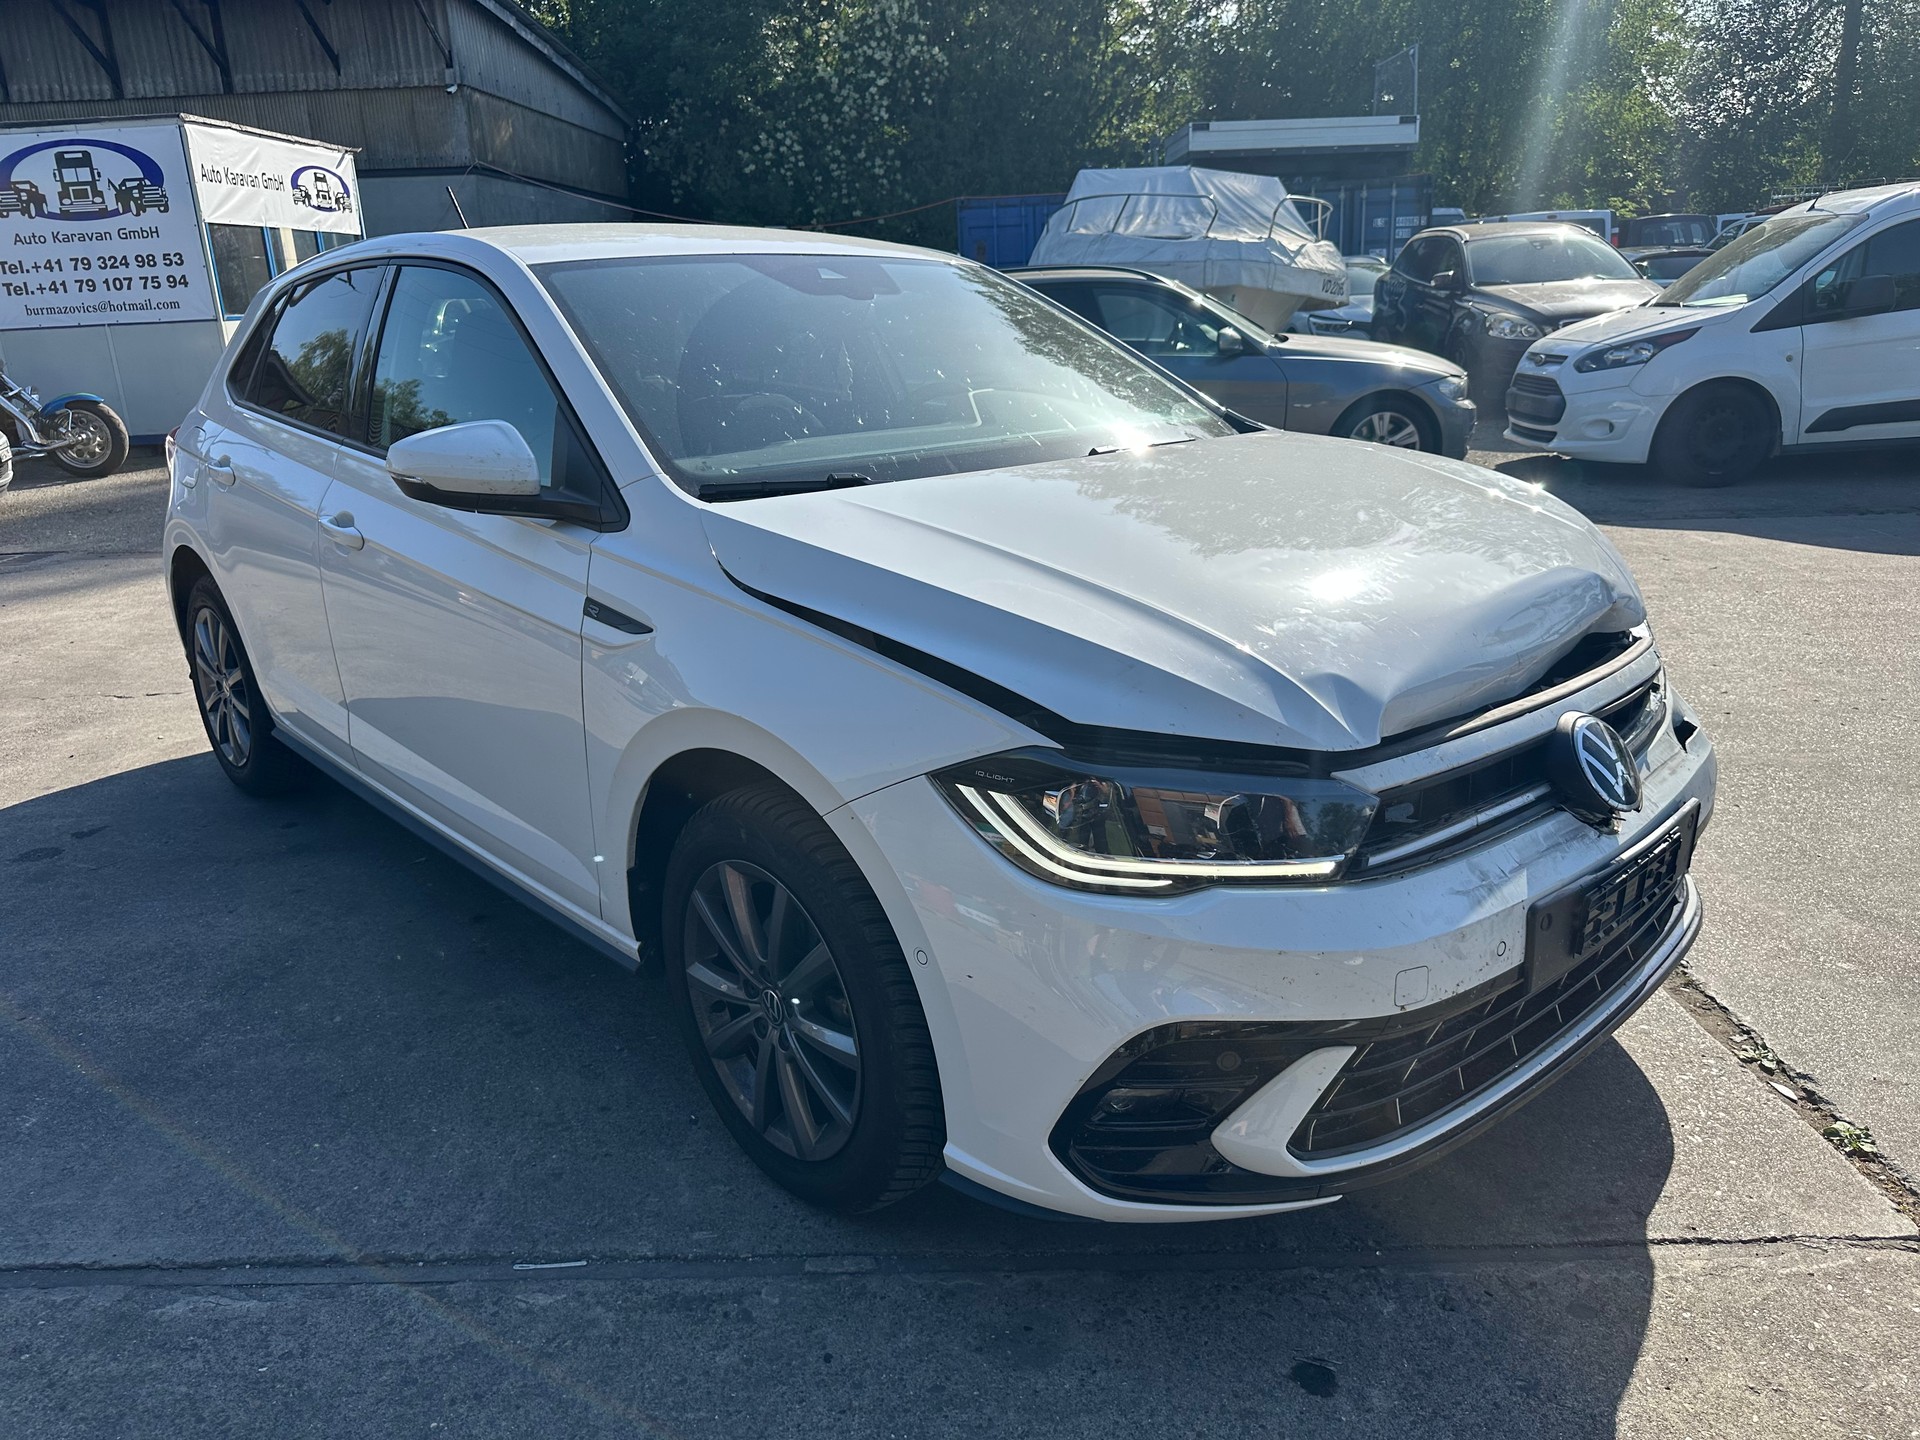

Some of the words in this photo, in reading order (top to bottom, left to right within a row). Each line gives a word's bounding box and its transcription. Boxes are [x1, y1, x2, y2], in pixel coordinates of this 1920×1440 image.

[201, 163, 222, 184] Auto
[223, 166, 260, 188] Karavan
[261, 172, 285, 192] GmbH
[14, 233, 47, 246] Auto
[52, 229, 113, 244] Karavan
[117, 226, 160, 240] GmbH
[0, 258, 63, 275] Tel.+41
[69, 256, 92, 272] 79
[97, 255, 130, 270] 324
[134, 253, 157, 268] 98
[162, 252, 185, 267] 53
[2, 280, 68, 297] Tel.+41
[74, 278, 97, 293] 79
[102, 276, 133, 292] 107
[139, 275, 161, 290] 75
[166, 274, 189, 289] 94
[25, 299, 181, 316] burmazovics@hotmail.com
